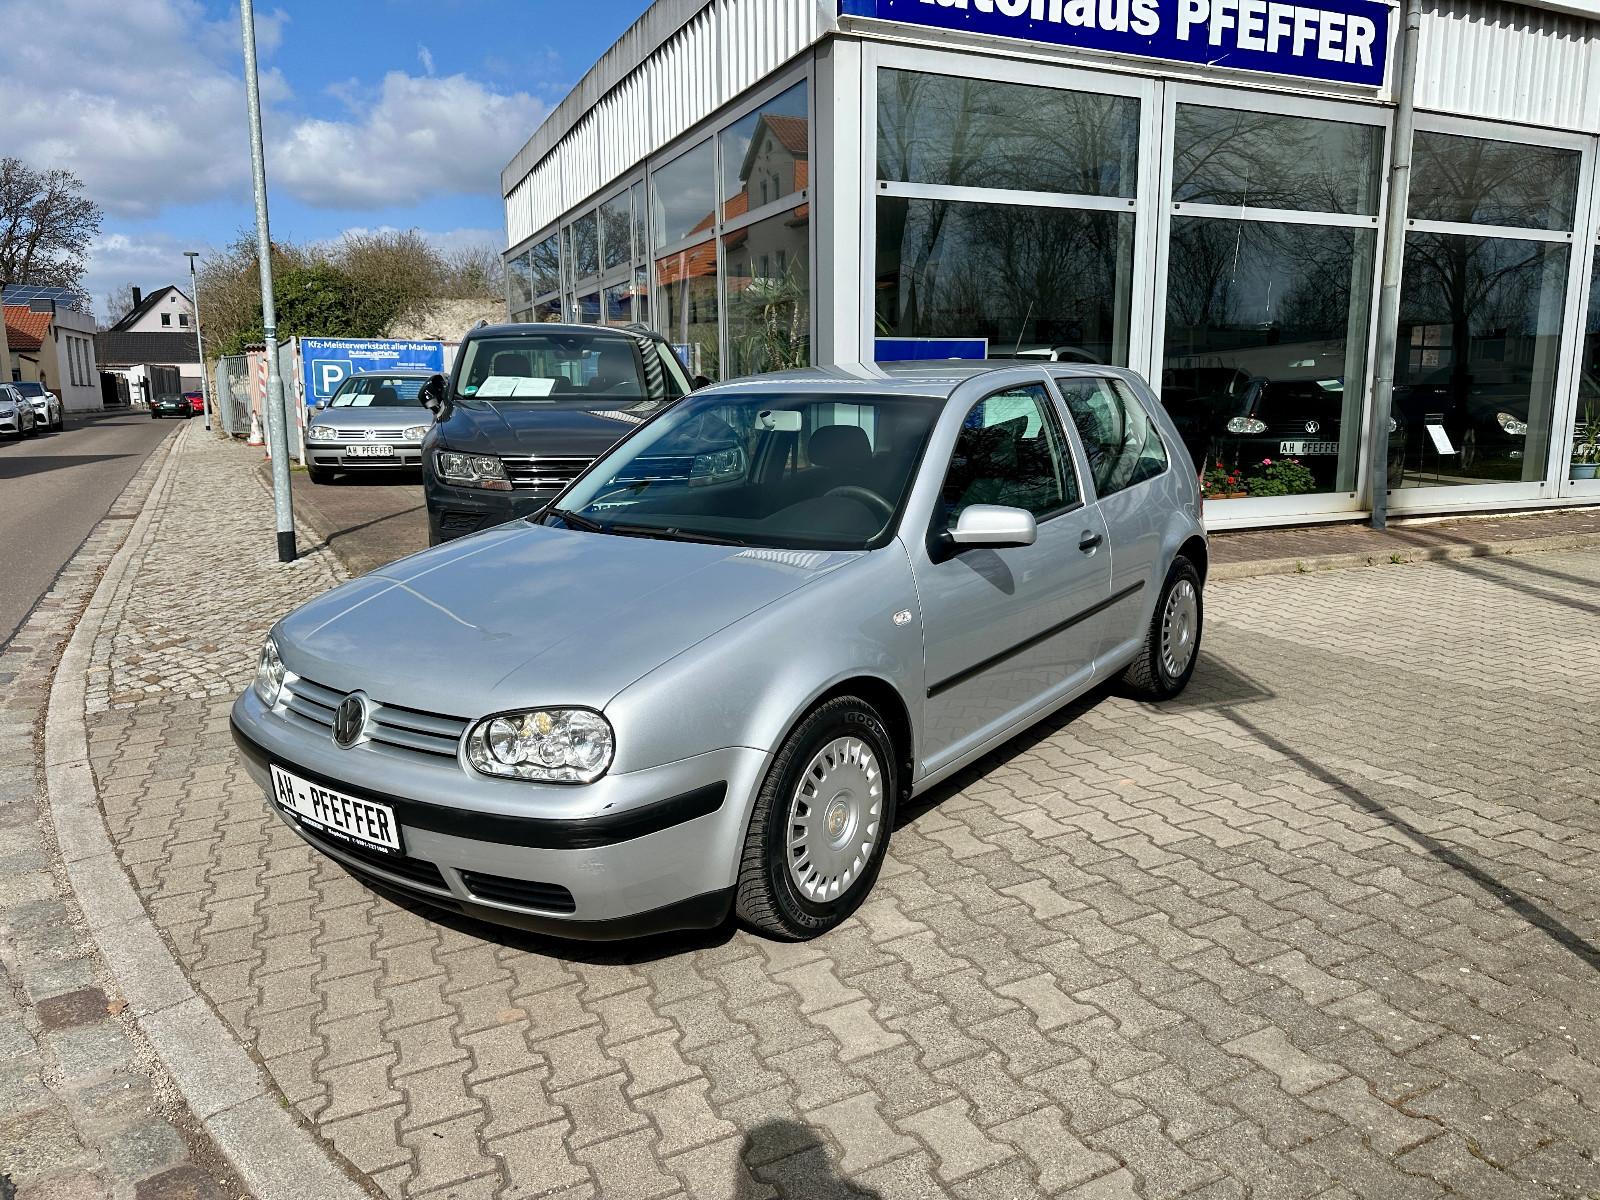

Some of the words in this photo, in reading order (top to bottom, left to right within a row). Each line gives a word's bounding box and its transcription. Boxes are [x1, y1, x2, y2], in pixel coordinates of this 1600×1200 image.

[1176, 0, 1376, 67] PFEFFER
[308, 341, 390, 350] Kfz-Meisterwerkstatt
[391, 343, 408, 351] aller
[409, 343, 437, 352] Marken
[322, 364, 344, 393] P
[347, 446, 357, 454] AH
[362, 446, 393, 454] PFEFFER
[1281, 443, 1295, 452] AH
[276, 771, 297, 807] AH
[310, 786, 392, 843] PFEFFER
